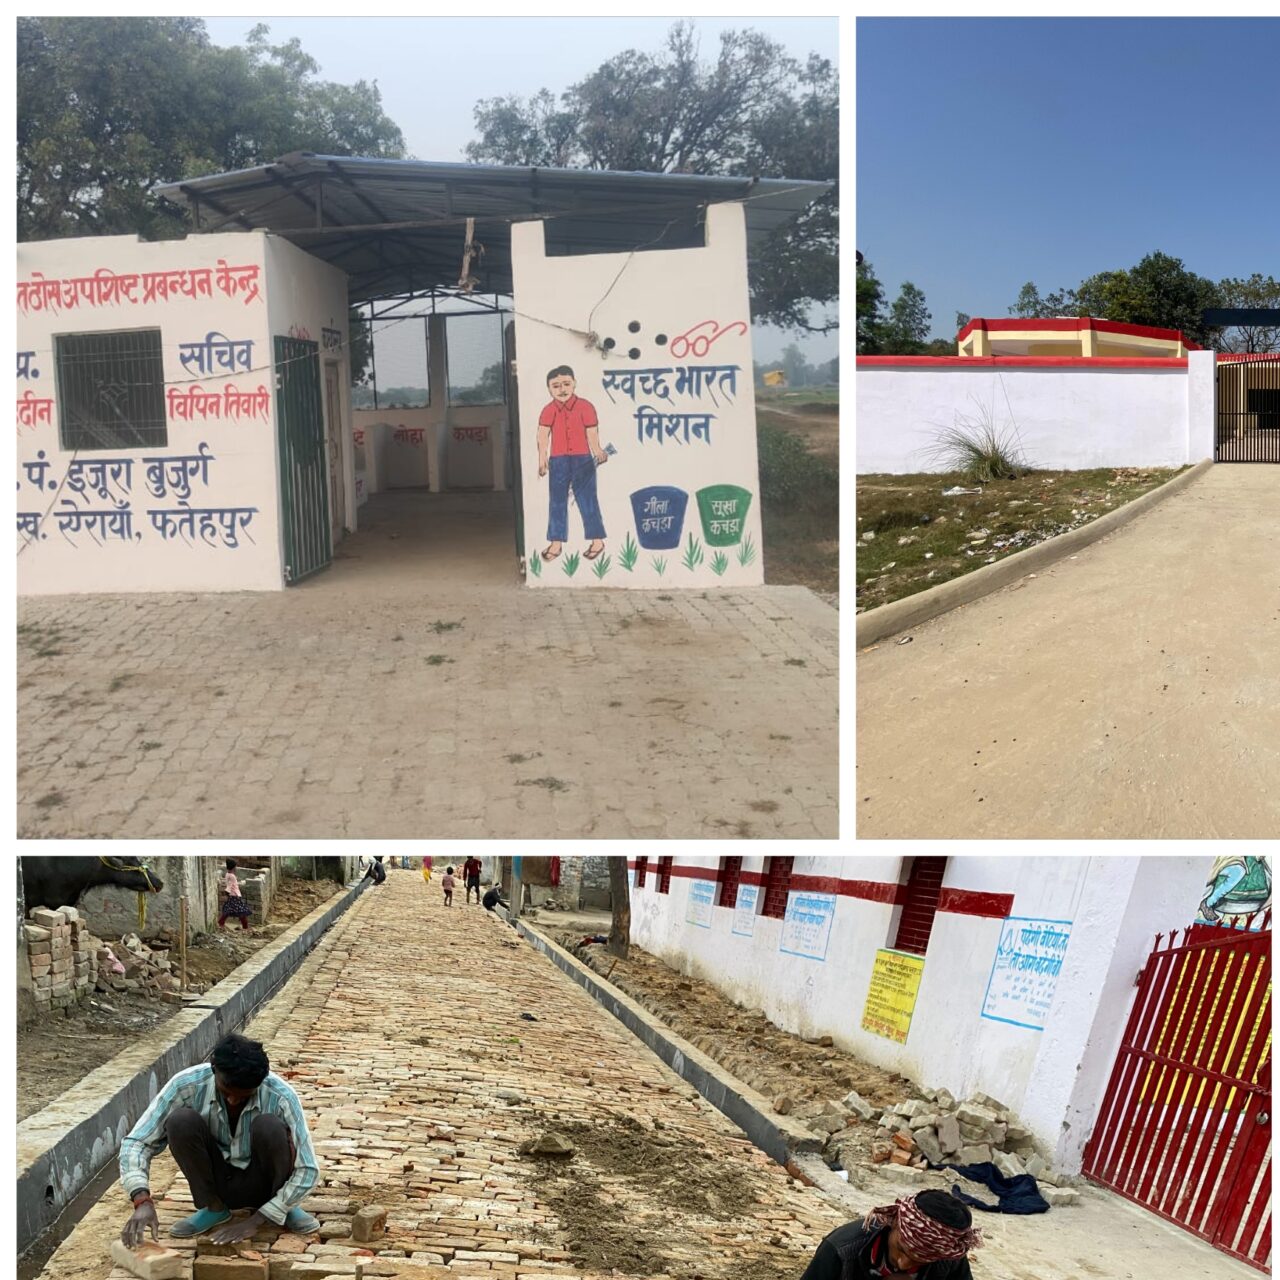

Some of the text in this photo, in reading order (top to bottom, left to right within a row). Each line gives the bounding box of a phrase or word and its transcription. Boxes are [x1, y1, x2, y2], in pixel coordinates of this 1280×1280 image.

[141, 269, 212, 304] प्रबन्धन
[216, 259, 262, 305] केन्द्र
[178, 331, 255, 378] सचिव
[166, 383, 271, 424] विपिन तिवारी
[602, 365, 742, 408] स्वच्छ भारत
[633, 405, 719, 446] मिशन
[142, 442, 216, 499] बुजुर्ग
[147, 501, 259, 549] फतेहपुर
[643, 496, 670, 515] गीला
